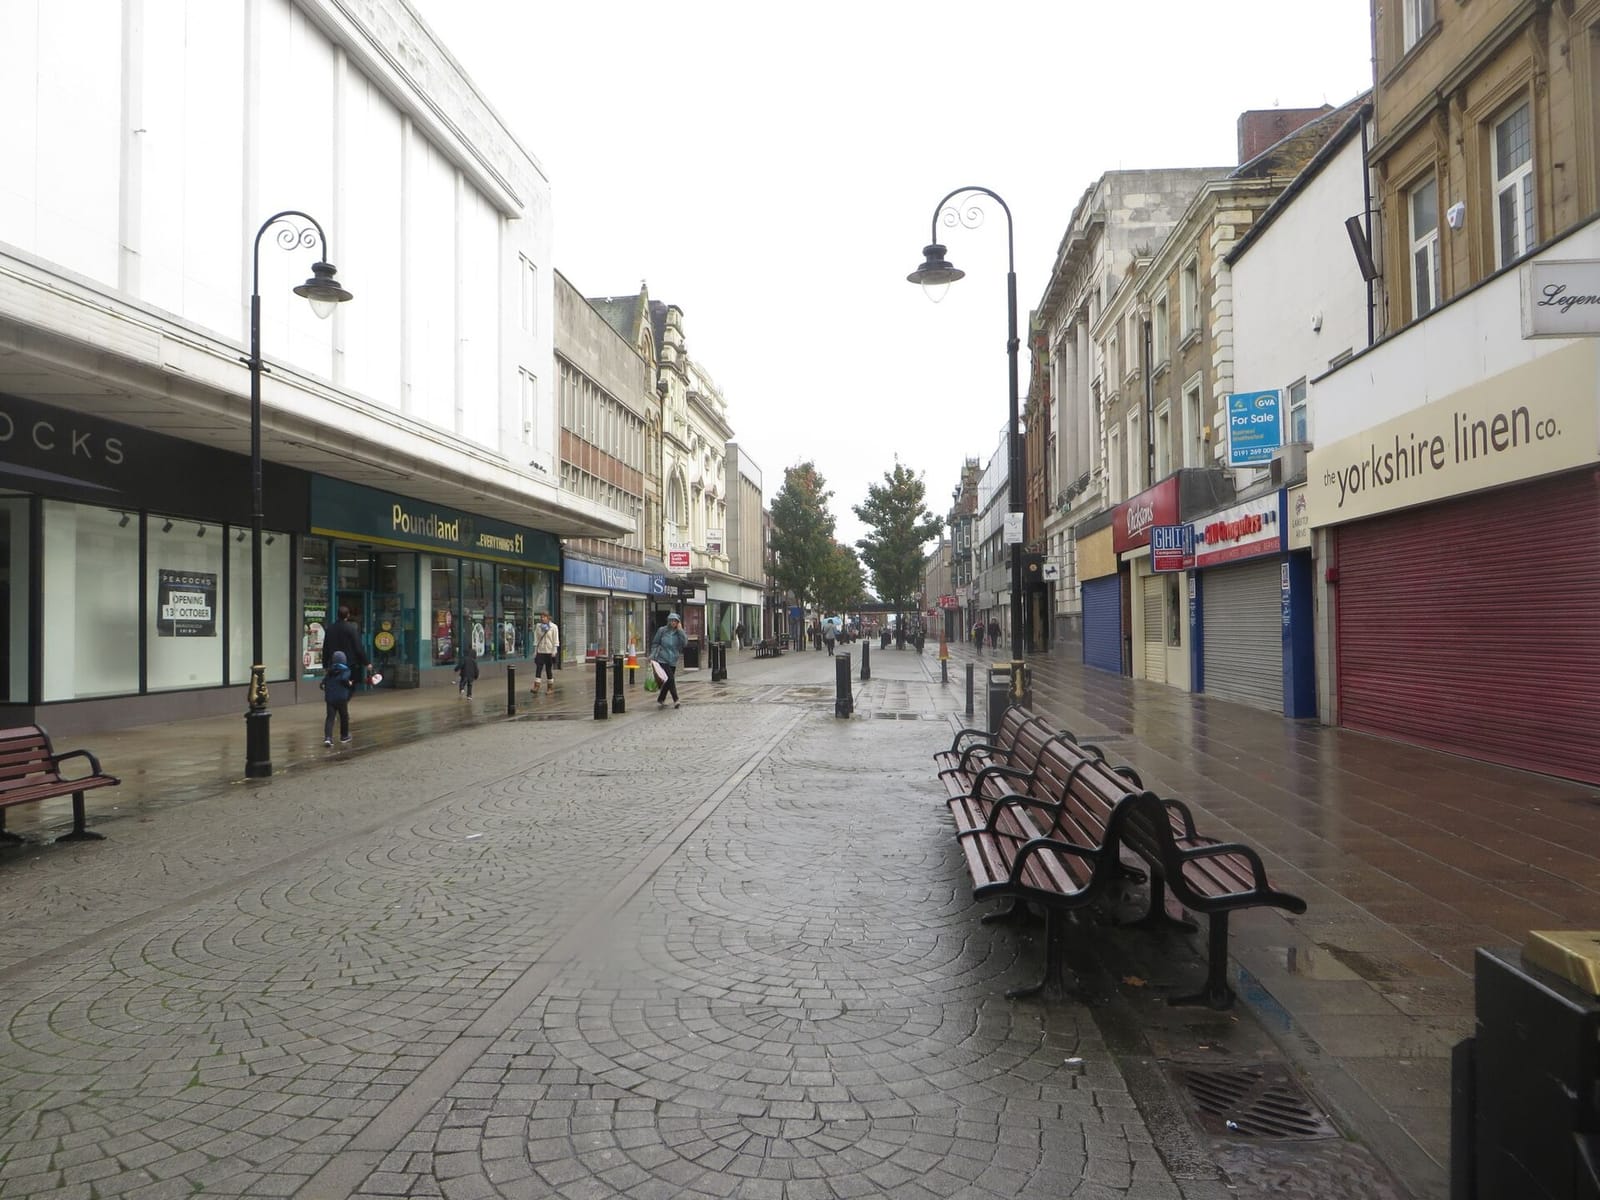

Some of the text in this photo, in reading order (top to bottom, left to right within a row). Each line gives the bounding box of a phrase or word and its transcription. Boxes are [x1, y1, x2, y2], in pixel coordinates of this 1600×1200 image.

[1258, 398, 1276, 408] GVA
[1231, 413, 1275, 426] For Sale
[1323, 405, 1562, 507] the yorkshire linen co.
[392, 504, 459, 542] Poundland
[514, 533, 524, 554] £1
[1155, 528, 1182, 548] GHI
[162, 575, 212, 586] PEACOCKS
[173, 595, 203, 605] OPENING
[179, 608, 209, 618] OCTOBER
